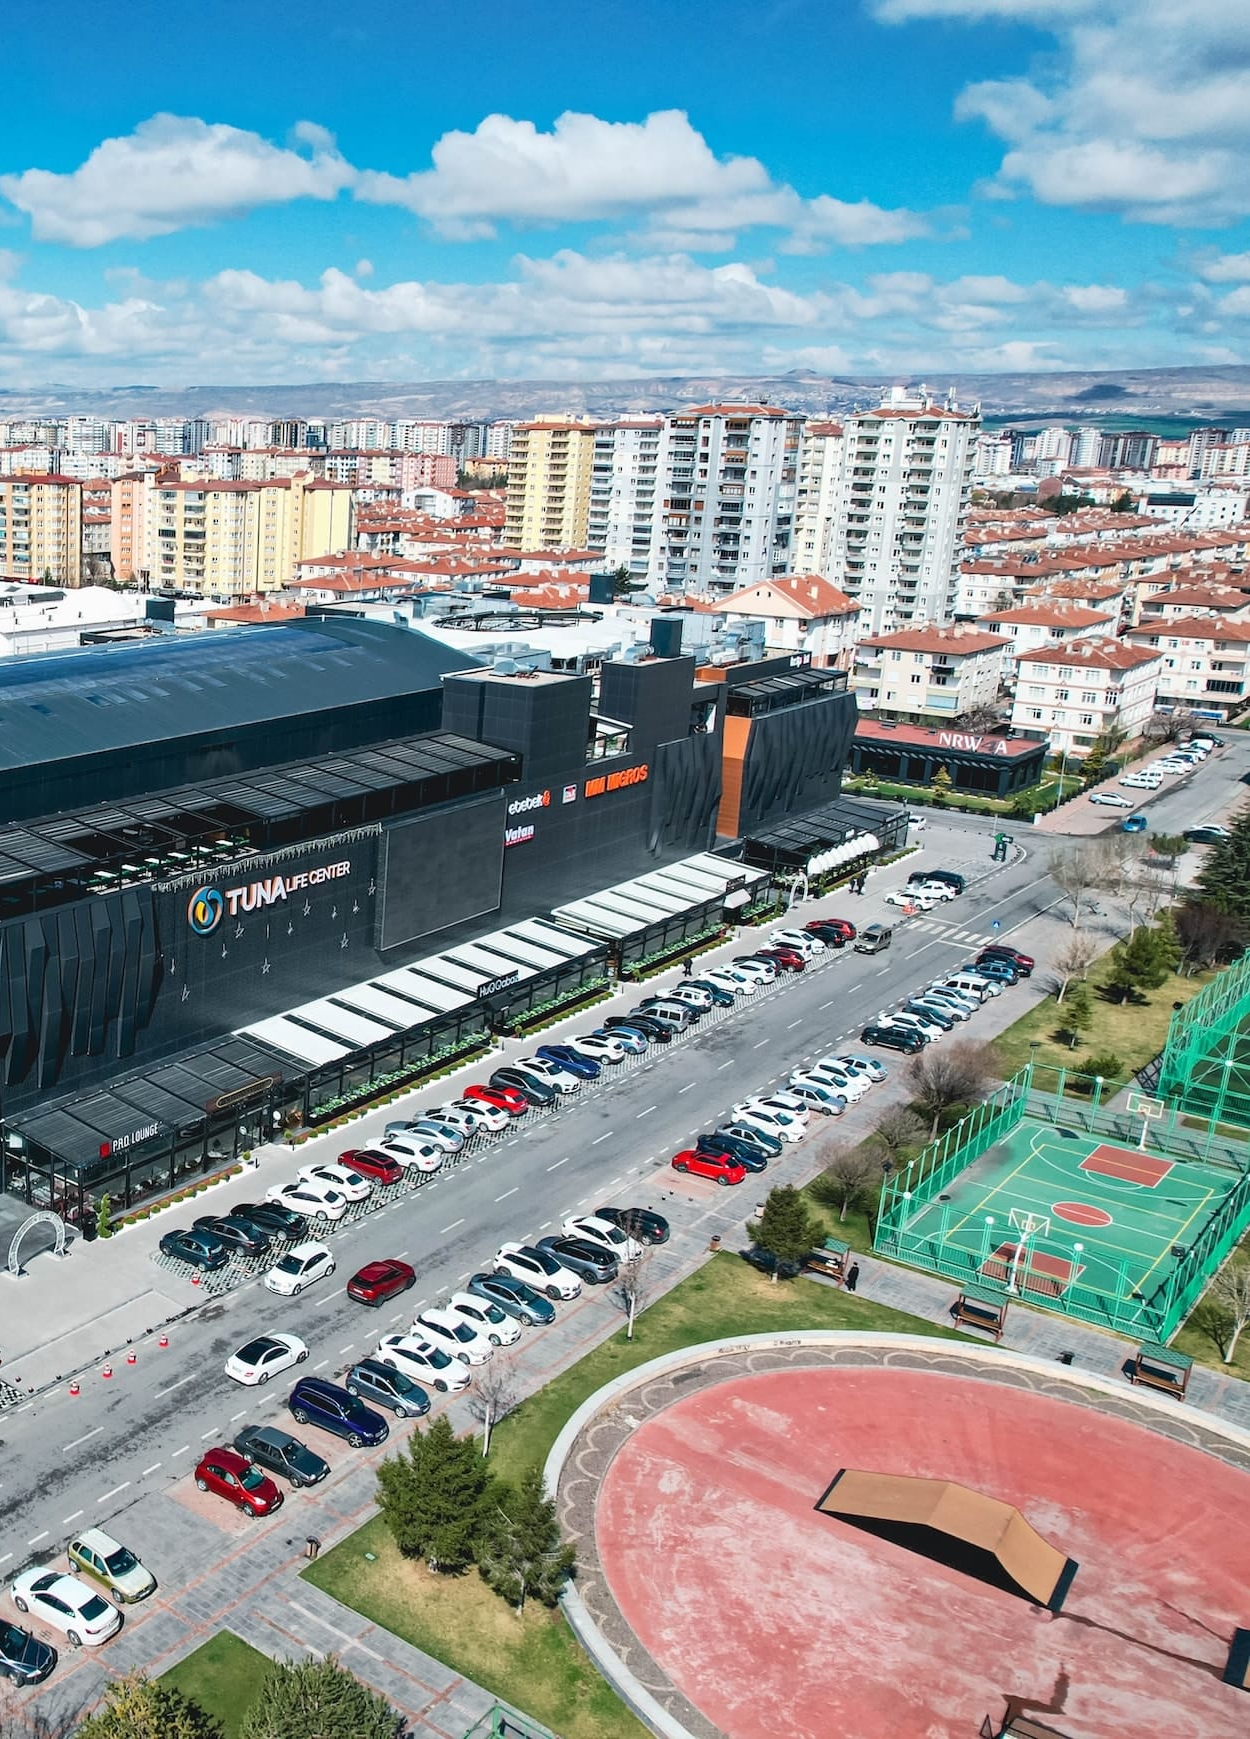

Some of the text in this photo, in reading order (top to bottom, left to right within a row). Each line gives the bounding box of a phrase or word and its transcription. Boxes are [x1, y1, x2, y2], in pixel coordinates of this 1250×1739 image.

[606, 765, 648, 791] MIGROS
[508, 793, 544, 815] ebebek
[505, 825, 535, 842] Vatan
[225, 861, 351, 915] TUNA LIFE CENTER
[131, 1122, 159, 1144] LOUNGE
